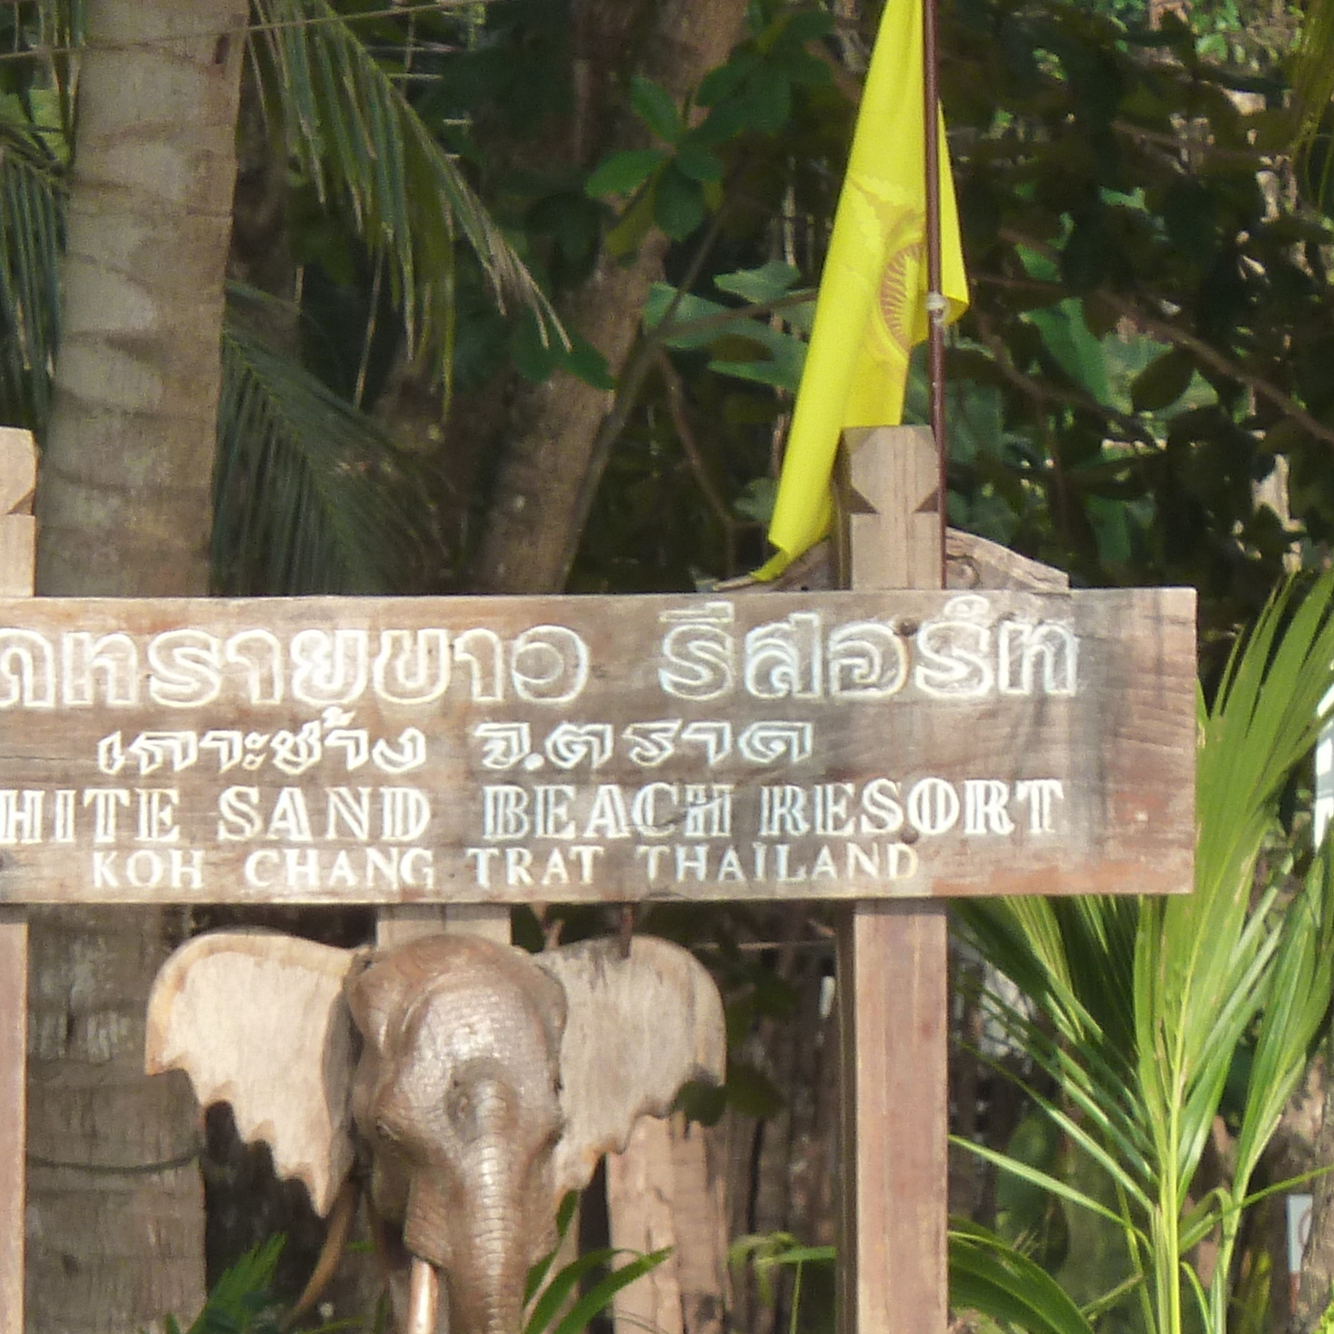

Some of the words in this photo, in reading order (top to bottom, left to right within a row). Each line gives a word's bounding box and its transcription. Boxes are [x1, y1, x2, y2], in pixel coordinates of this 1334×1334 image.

[657, 594, 1080, 701] รีสอร์ท
[97, 706, 427, 775] เกาะช้าง
[218, 785, 432, 843] SAND
[482, 782, 735, 841] BEACH
[759, 777, 1065, 838] RESORT
[92, 848, 205, 889] KOH
[244, 847, 435, 890] CHANG
[467, 845, 605, 889] TRAT
[634, 842, 919, 883] THAILAND
